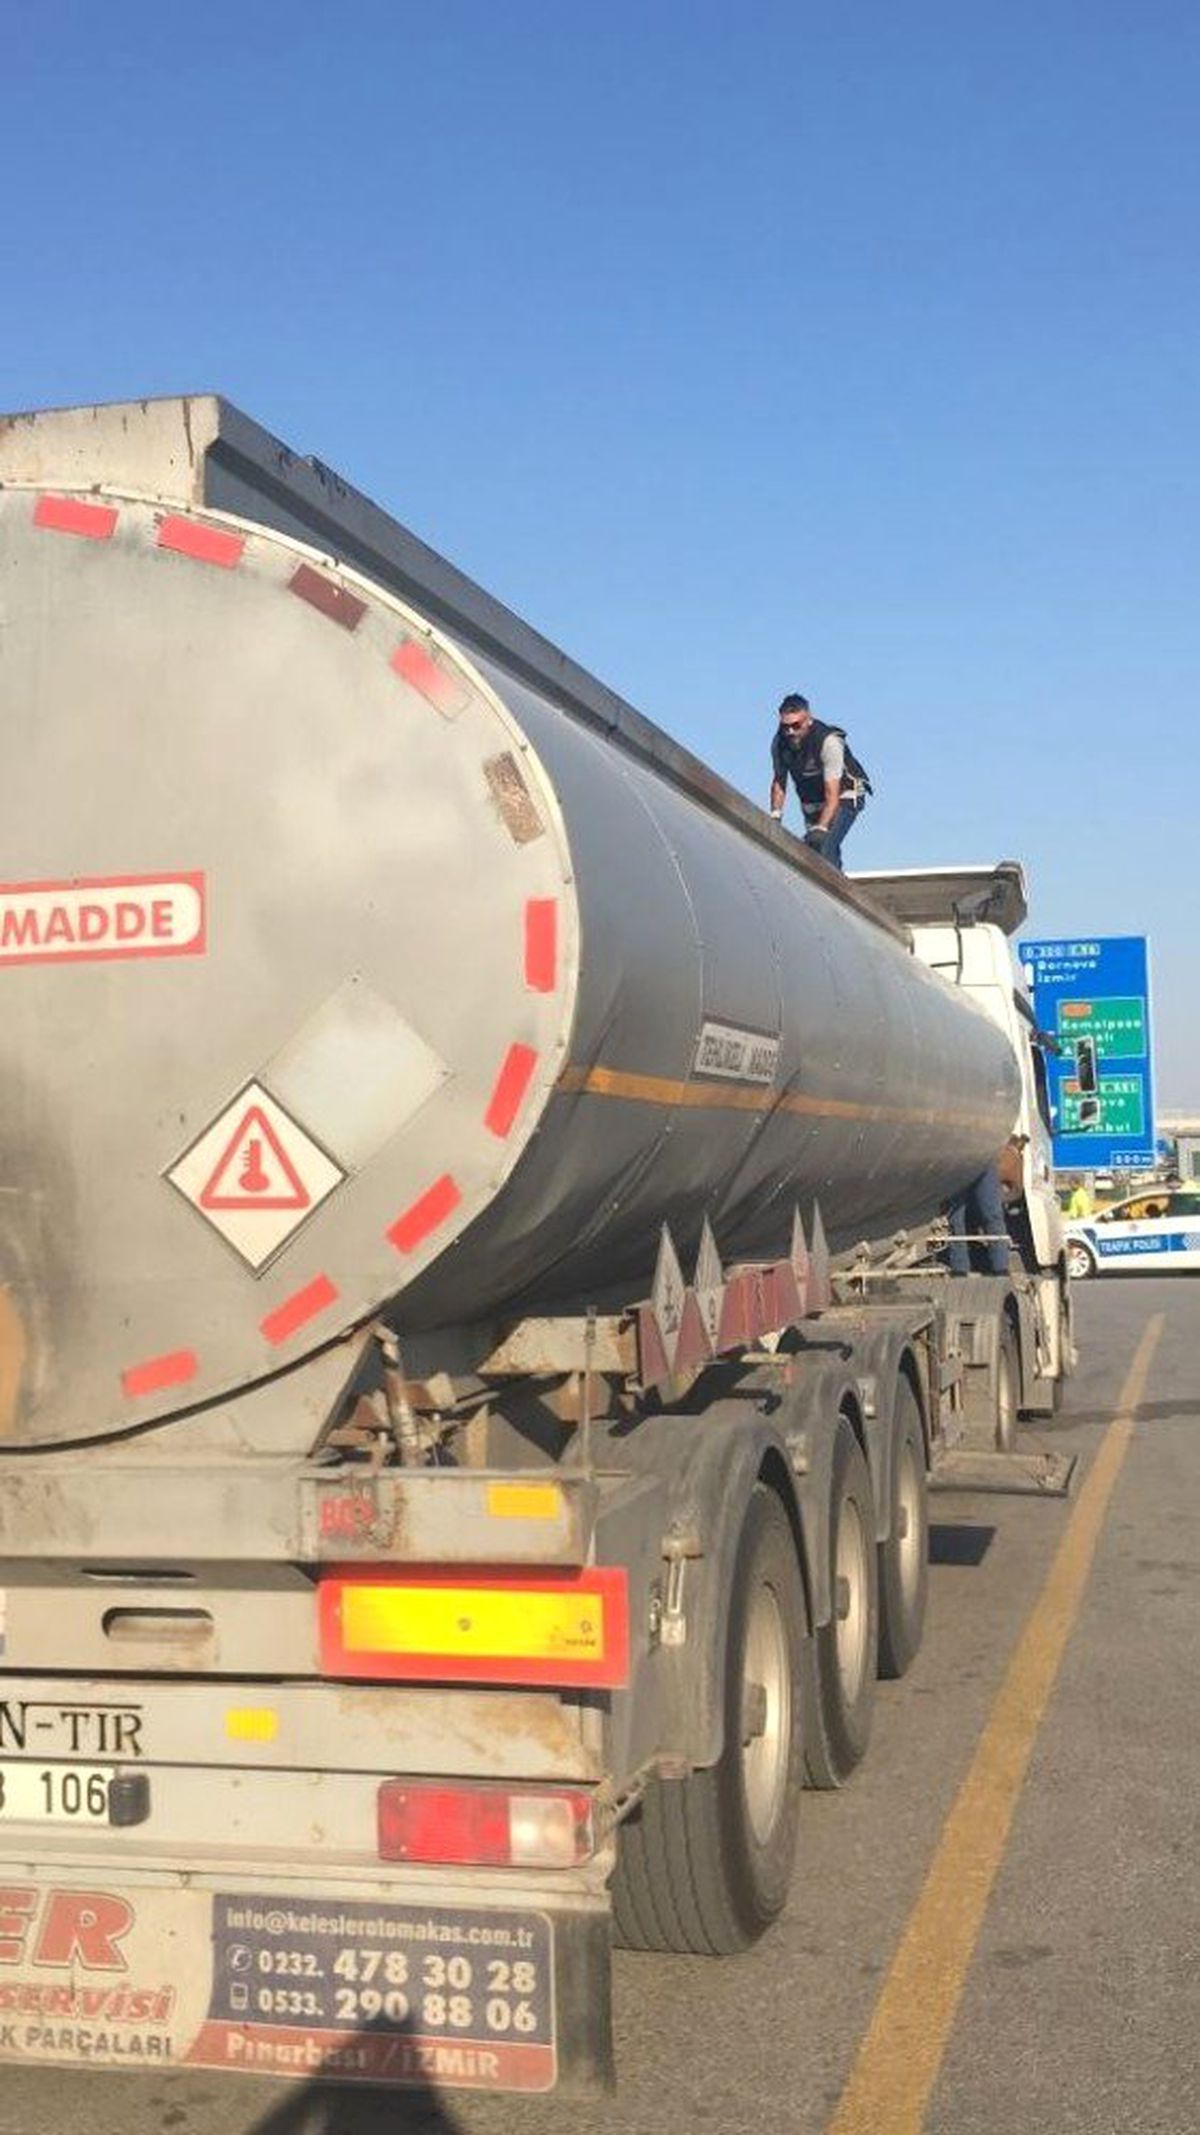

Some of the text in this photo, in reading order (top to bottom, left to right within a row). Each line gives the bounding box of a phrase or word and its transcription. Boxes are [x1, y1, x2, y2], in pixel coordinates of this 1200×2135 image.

[1, 900, 173, 947] MADDE
[40, 1769, 107, 1816] 106
[258, 1948, 537, 1994] 0232. 478 30 28
[258, 1988, 538, 2032] 0533. 290 88 06
[25, 2026, 172, 2057] PARÇALARI
